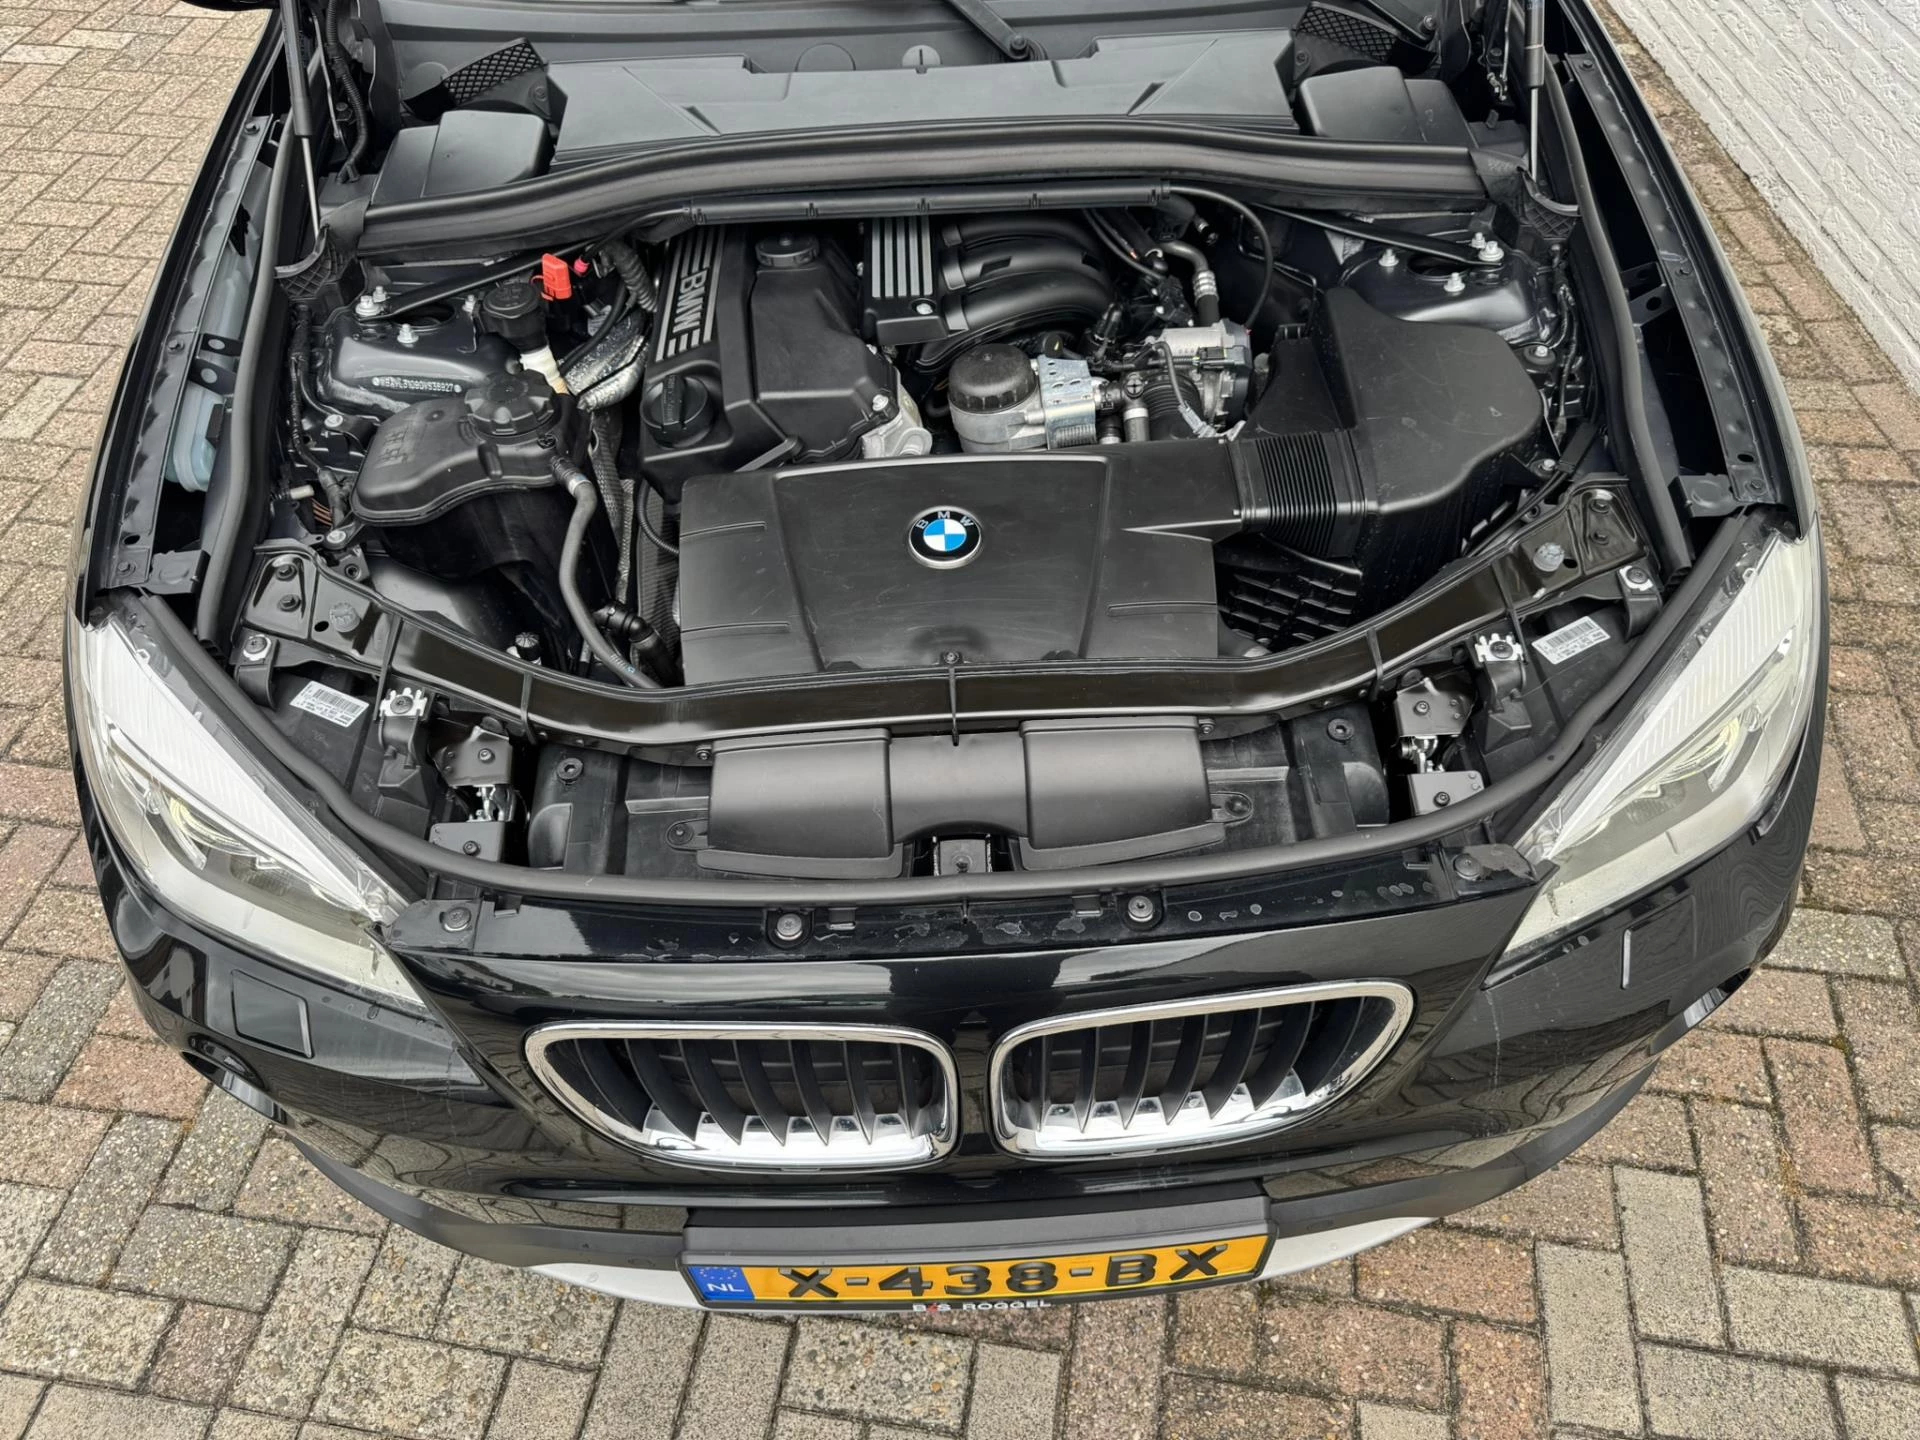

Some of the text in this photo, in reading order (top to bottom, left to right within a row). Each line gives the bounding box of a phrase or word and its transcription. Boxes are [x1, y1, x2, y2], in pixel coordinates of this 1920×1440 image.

[672, 269, 708, 334] BMW
[915, 510, 975, 530] BMW
[778, 1243, 1228, 1298] X-438-BX
[707, 1282, 745, 1294] NL
[962, 1299, 1052, 1311] ROGGEL
